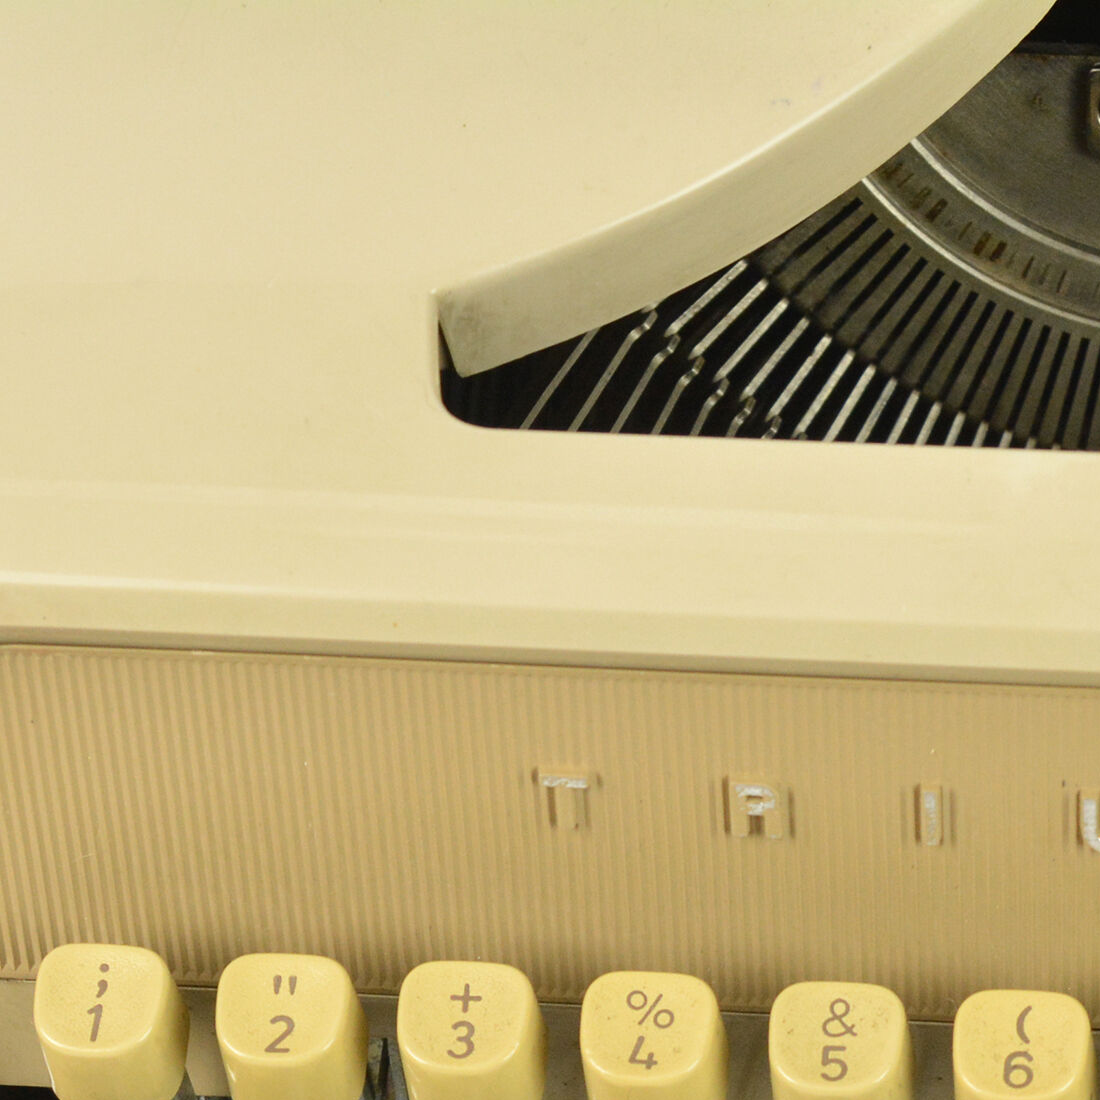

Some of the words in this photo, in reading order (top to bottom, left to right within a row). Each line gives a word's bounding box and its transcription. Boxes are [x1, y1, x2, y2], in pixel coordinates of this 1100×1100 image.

[95, 962, 110, 998] ;
[449, 983, 483, 1014] +
[86, 1003, 104, 1042] 1
[625, 989, 675, 1030] %
[821, 997, 858, 1038] &
[1015, 1005, 1033, 1045] (
[264, 1014, 296, 1054] 2
[446, 1020, 476, 1060] 3
[627, 1035, 659, 1071] 4
[820, 1044, 849, 1082] 5
[1002, 1050, 1034, 1090] 6
